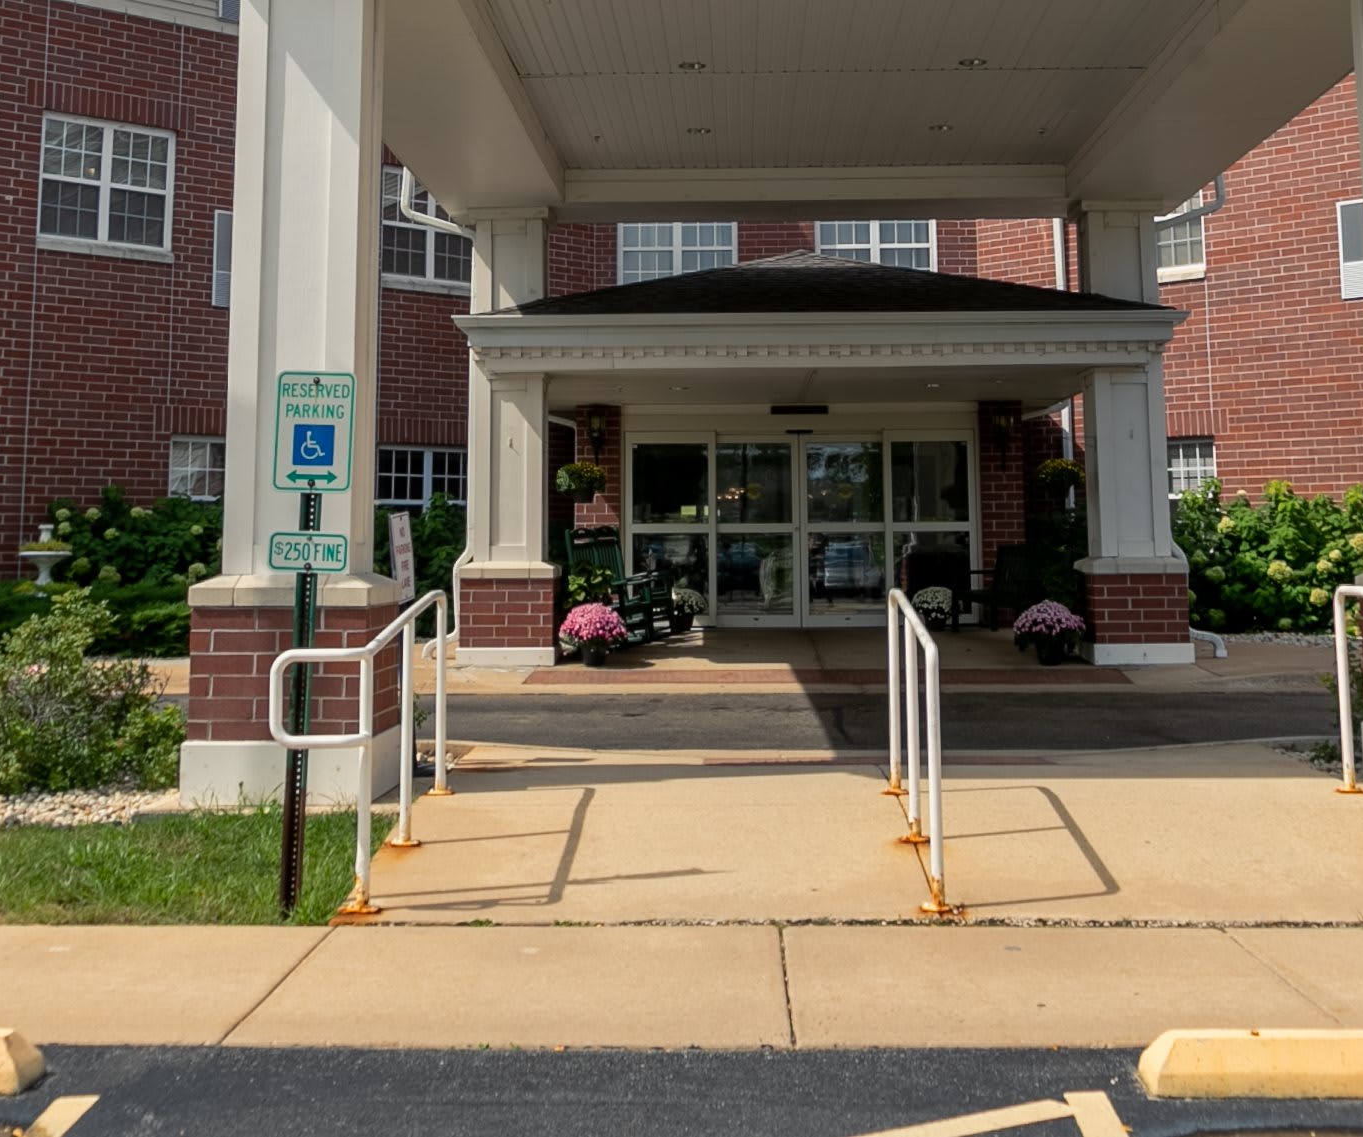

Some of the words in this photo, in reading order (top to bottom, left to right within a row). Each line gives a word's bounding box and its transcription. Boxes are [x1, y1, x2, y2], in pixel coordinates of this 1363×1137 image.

[282, 382, 350, 399] RESERVED
[285, 403, 345, 419] PARKING
[273, 541, 311, 561] $250
[313, 543, 343, 562] FINE
